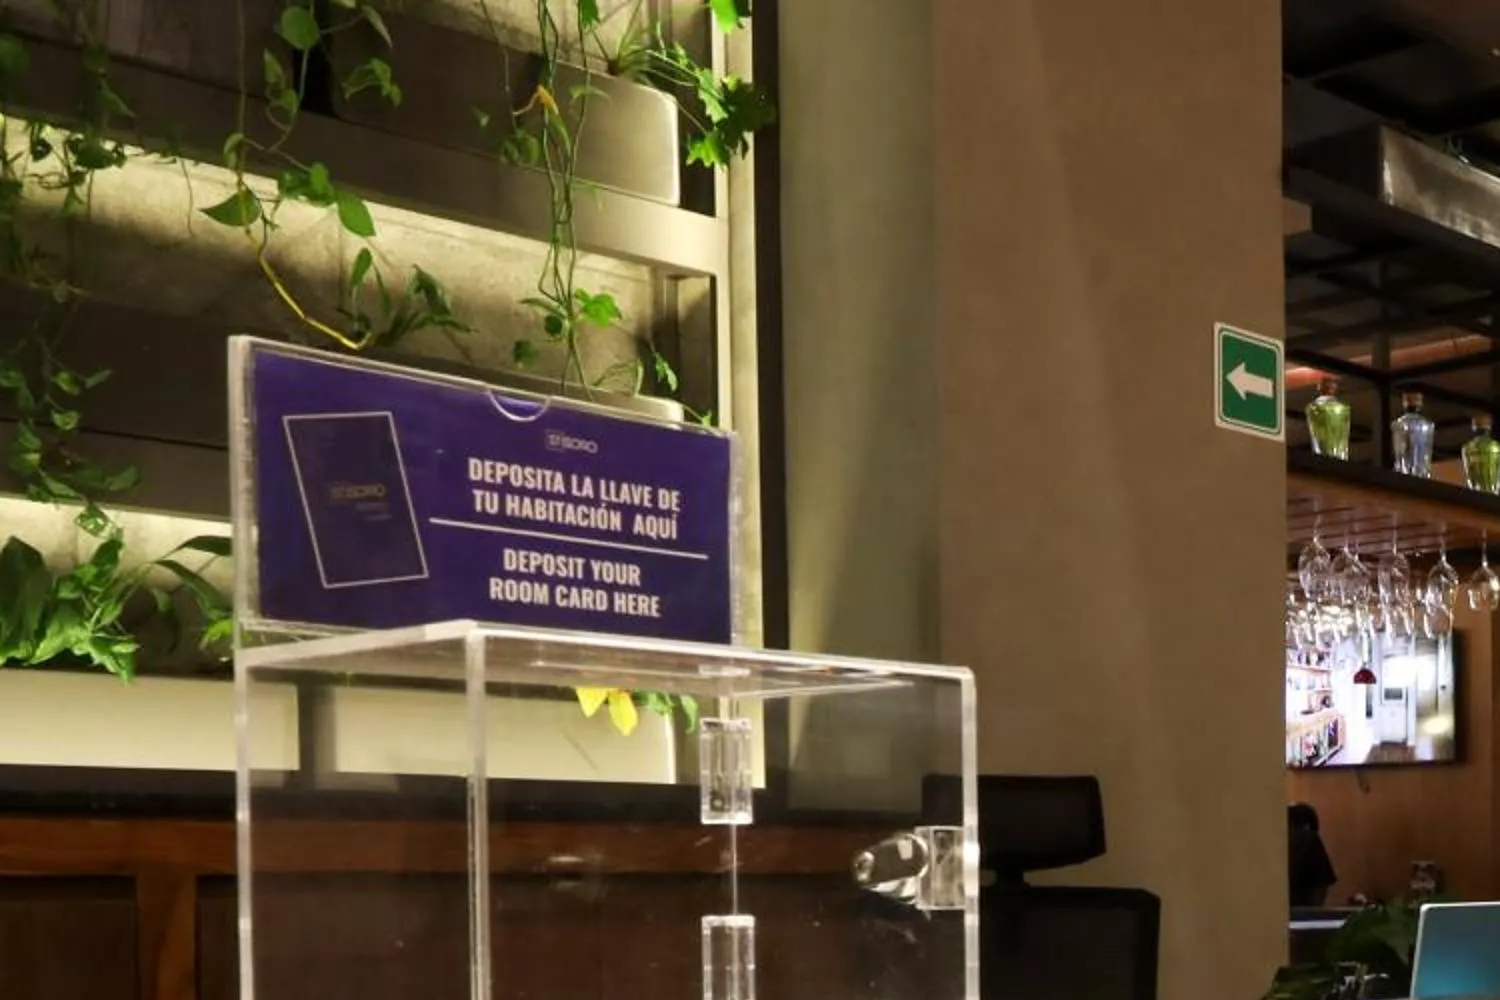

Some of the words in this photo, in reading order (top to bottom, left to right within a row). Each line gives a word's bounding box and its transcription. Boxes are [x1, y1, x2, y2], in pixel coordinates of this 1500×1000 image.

[468, 457, 566, 495] DEPOSITA
[571, 474, 594, 498] LA
[600, 478, 653, 507] LLAVE
[658, 487, 681, 512] DE
[472, 489, 499, 515] TU
[505, 494, 622, 531] HABITACIÓN
[633, 512, 678, 540] AQUÍ
[503, 548, 586, 579] DEPOSIT
[590, 559, 641, 587] YOUR
[489, 577, 549, 605] ROOM
[555, 584, 608, 611] CARD
[613, 591, 662, 618] HERE
